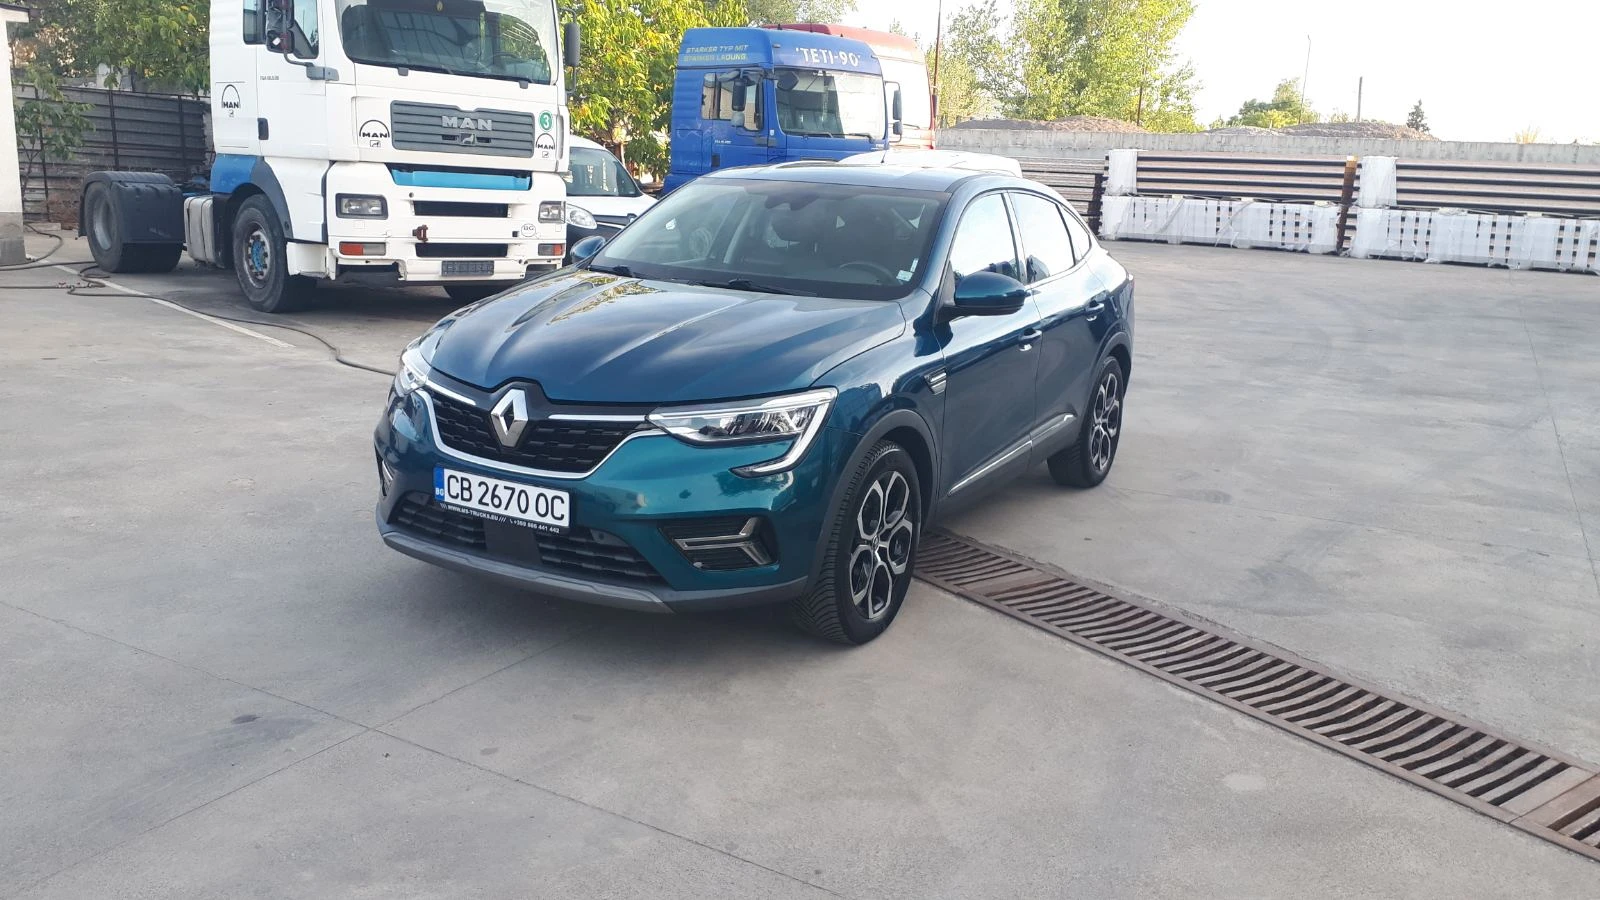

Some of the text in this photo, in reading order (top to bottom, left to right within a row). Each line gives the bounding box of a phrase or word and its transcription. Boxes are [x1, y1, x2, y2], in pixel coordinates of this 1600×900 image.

[686, 45, 718, 54] STARKER
[734, 44, 750, 52] MIT
[716, 53, 747, 62] LADUNG
[222, 101, 239, 109] MAN
[441, 115, 493, 131] MAN
[542, 112, 550, 129] 3
[435, 487, 445, 497] BG
[447, 474, 565, 521] CB 2670 OC
